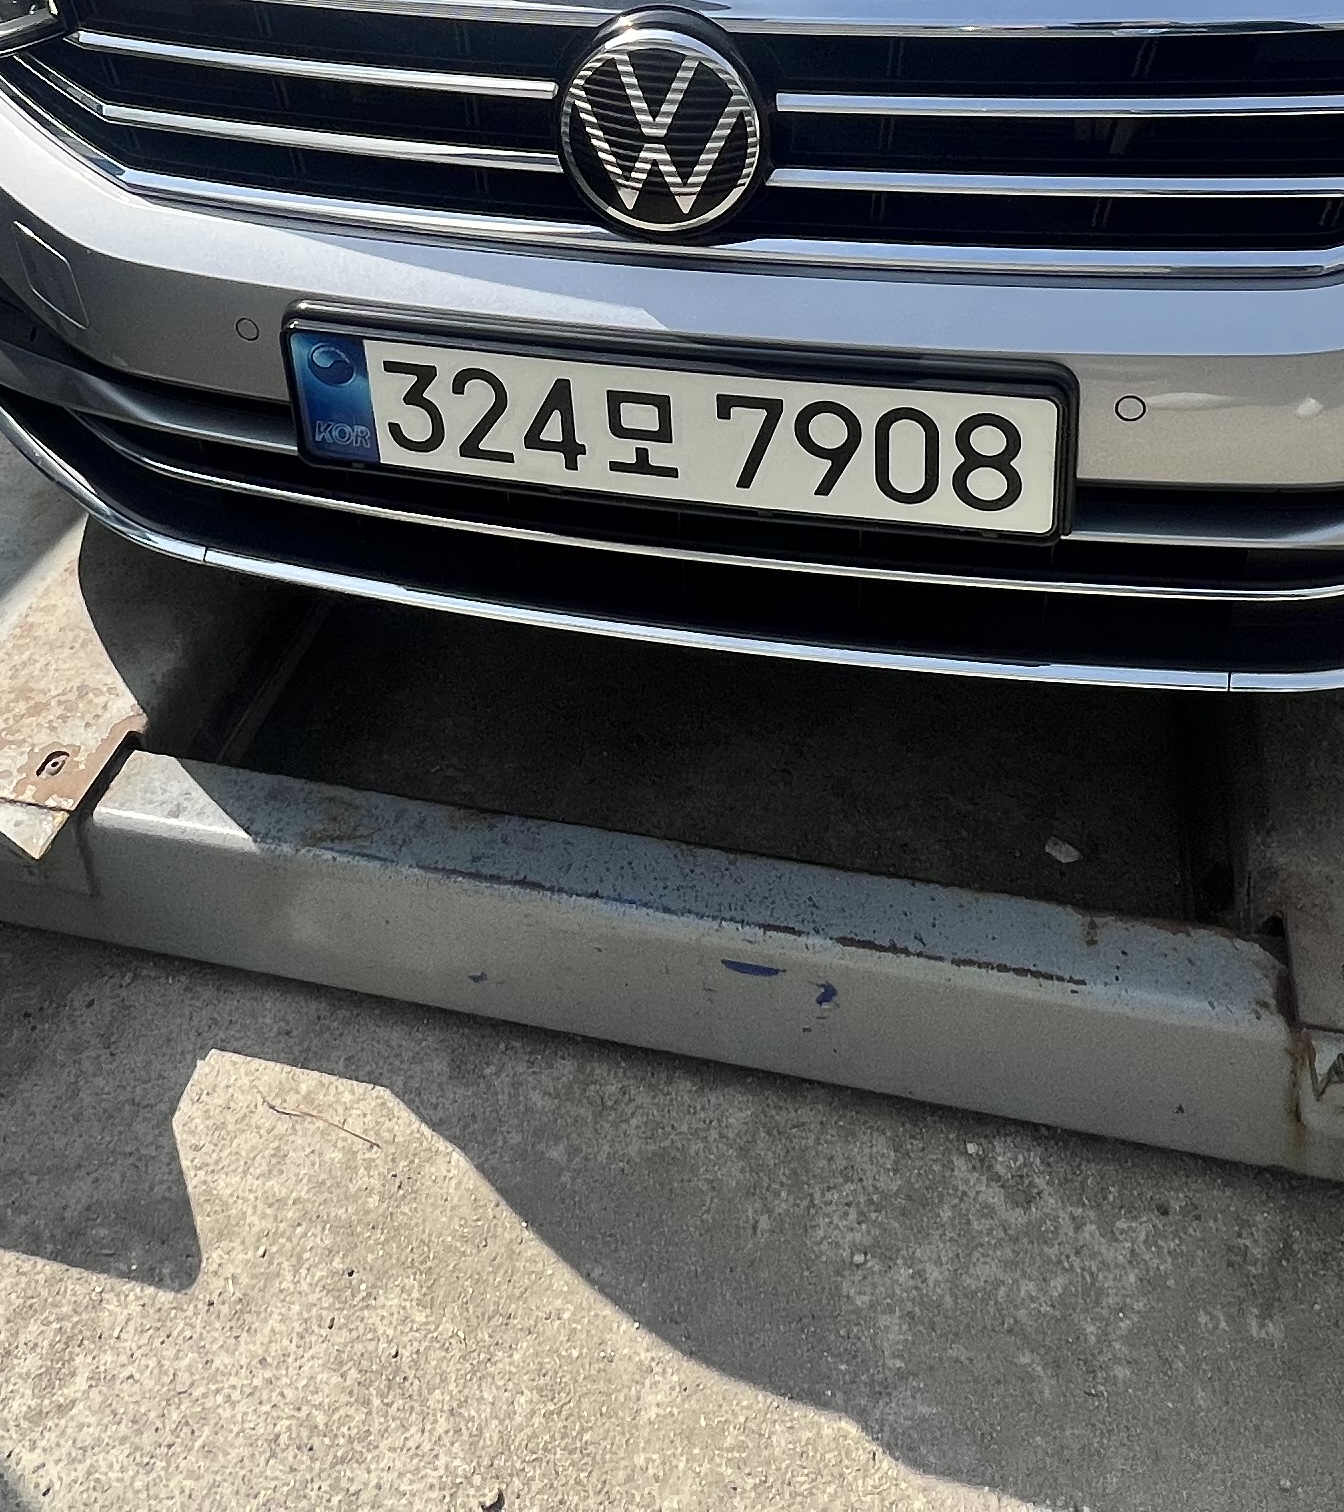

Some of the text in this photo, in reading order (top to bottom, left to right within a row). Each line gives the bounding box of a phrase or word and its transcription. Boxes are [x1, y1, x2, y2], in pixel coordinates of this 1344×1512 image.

[314, 420, 371, 449] KOR
[382, 360, 1024, 512] 324모 7908
